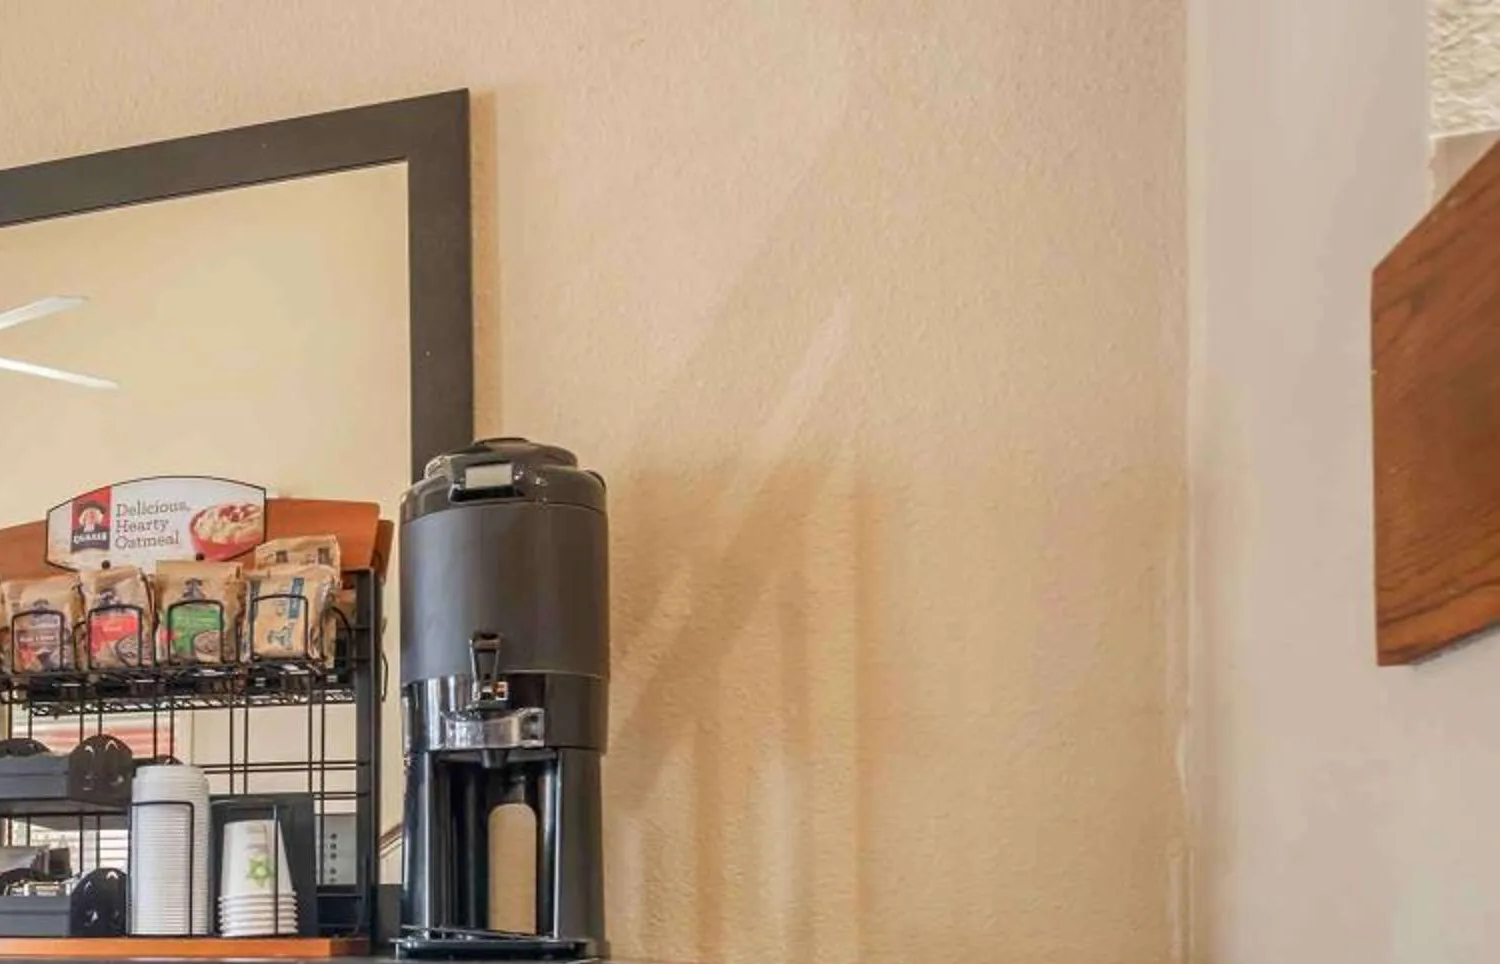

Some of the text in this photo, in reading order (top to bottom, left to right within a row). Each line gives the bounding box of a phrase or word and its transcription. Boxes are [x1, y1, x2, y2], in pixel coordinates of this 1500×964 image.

[115, 499, 191, 518] Delicious,
[115, 518, 169, 535] Hearty
[114, 530, 180, 550] Oatmeal
